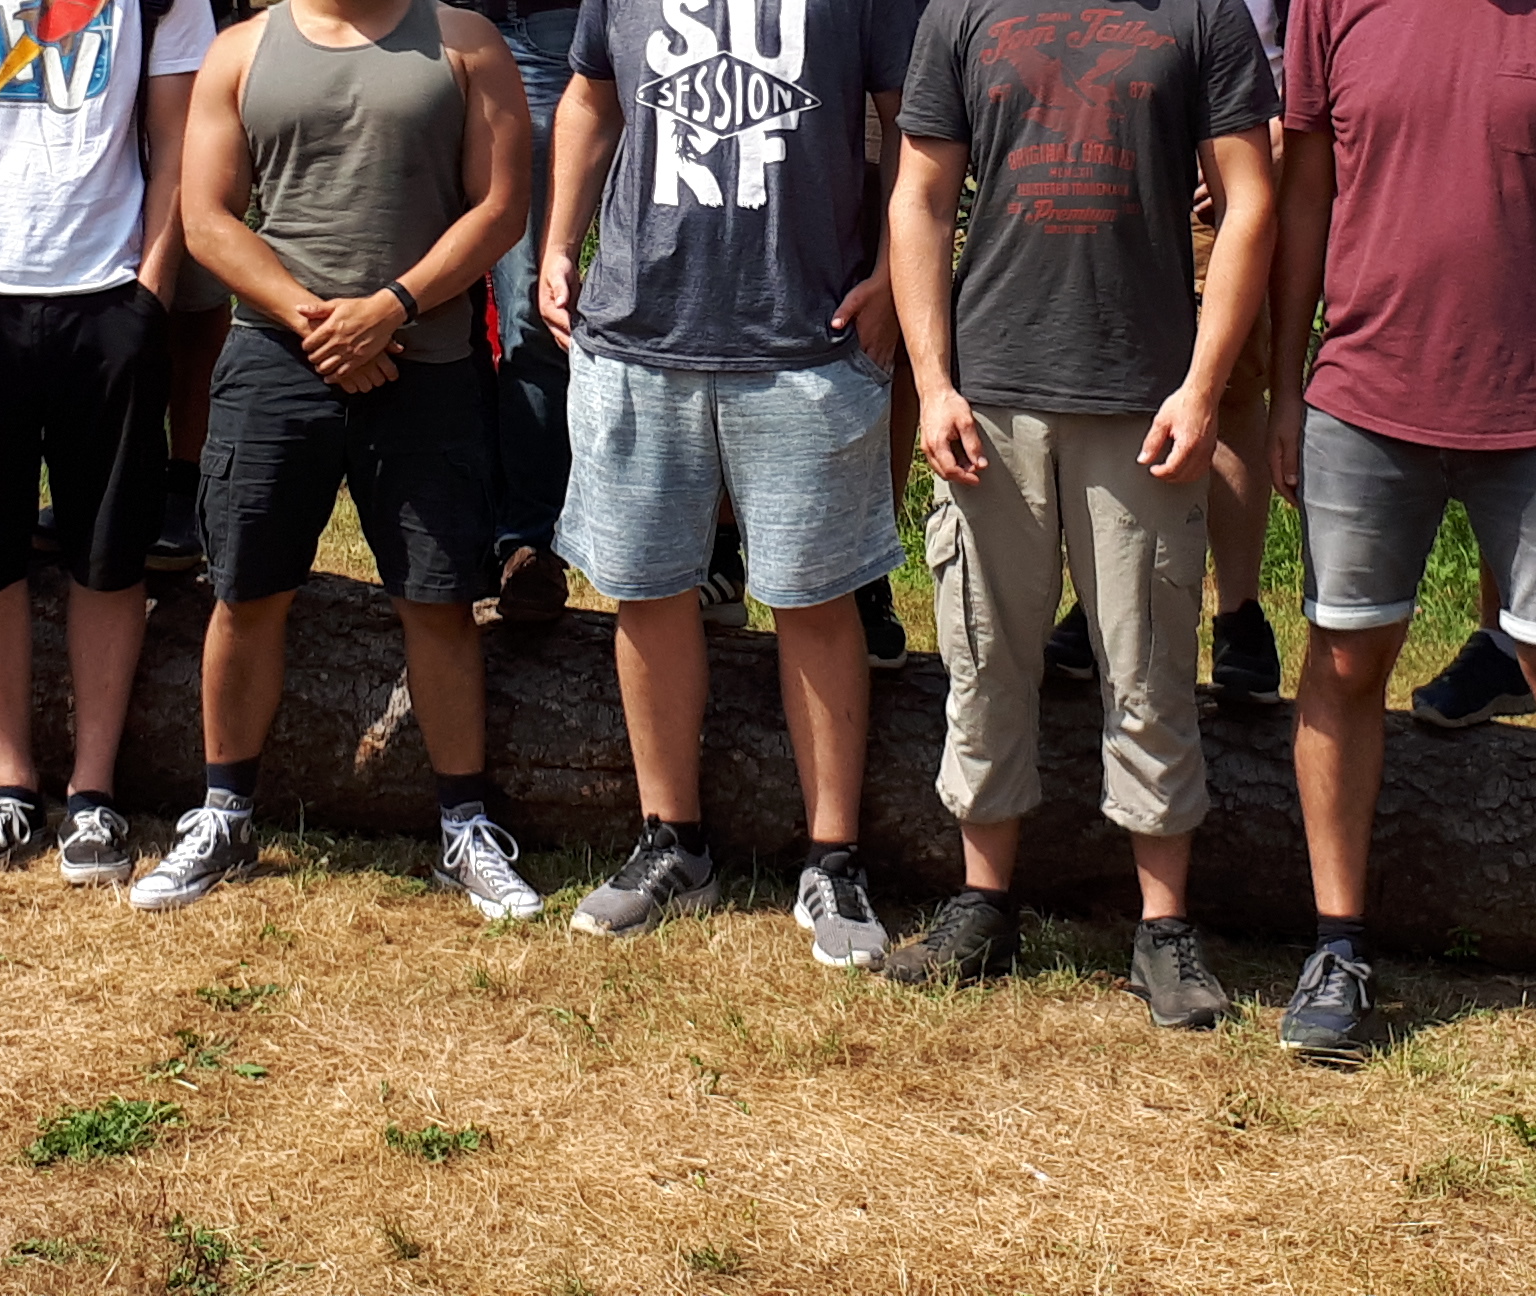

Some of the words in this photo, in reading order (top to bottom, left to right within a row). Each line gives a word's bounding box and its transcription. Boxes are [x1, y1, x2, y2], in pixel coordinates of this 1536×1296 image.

[980, 16, 1056, 65] Tom
[1066, 8, 1177, 50] Tailor
[657, 58, 793, 131] SESSION
[1007, 142, 1077, 171] ORIGINAL
[1081, 140, 1136, 171] BRAND
[1024, 199, 1118, 224] Premium
